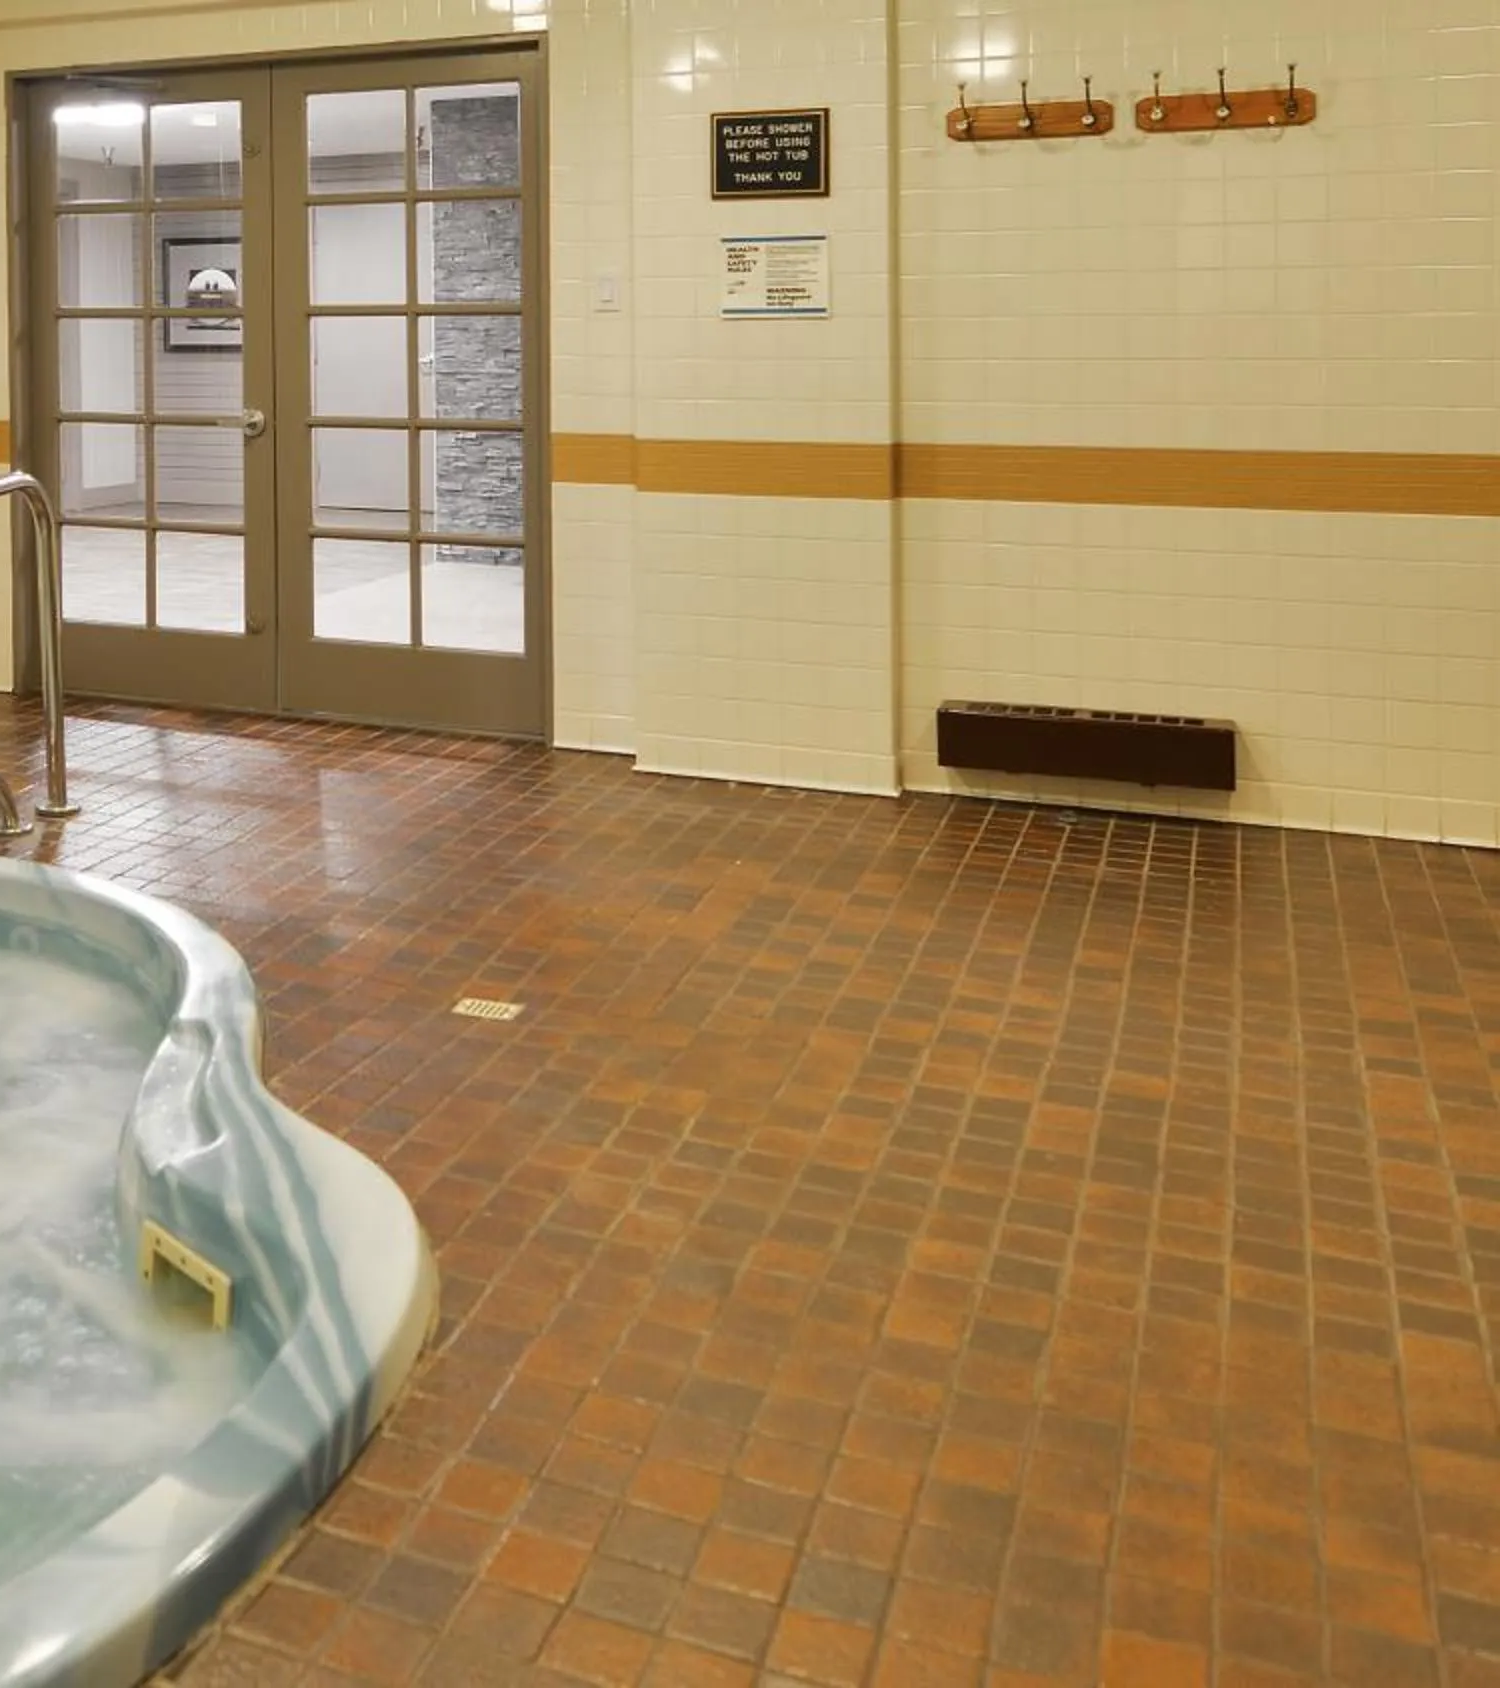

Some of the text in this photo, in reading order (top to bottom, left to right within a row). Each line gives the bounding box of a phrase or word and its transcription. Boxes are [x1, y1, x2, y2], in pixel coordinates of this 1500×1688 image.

[723, 123, 812, 135] PLEASE SHOWER
[726, 137, 810, 149] BEFORE USING
[728, 150, 809, 162] THE HOT TUB
[734, 171, 802, 183] THANK YOU
